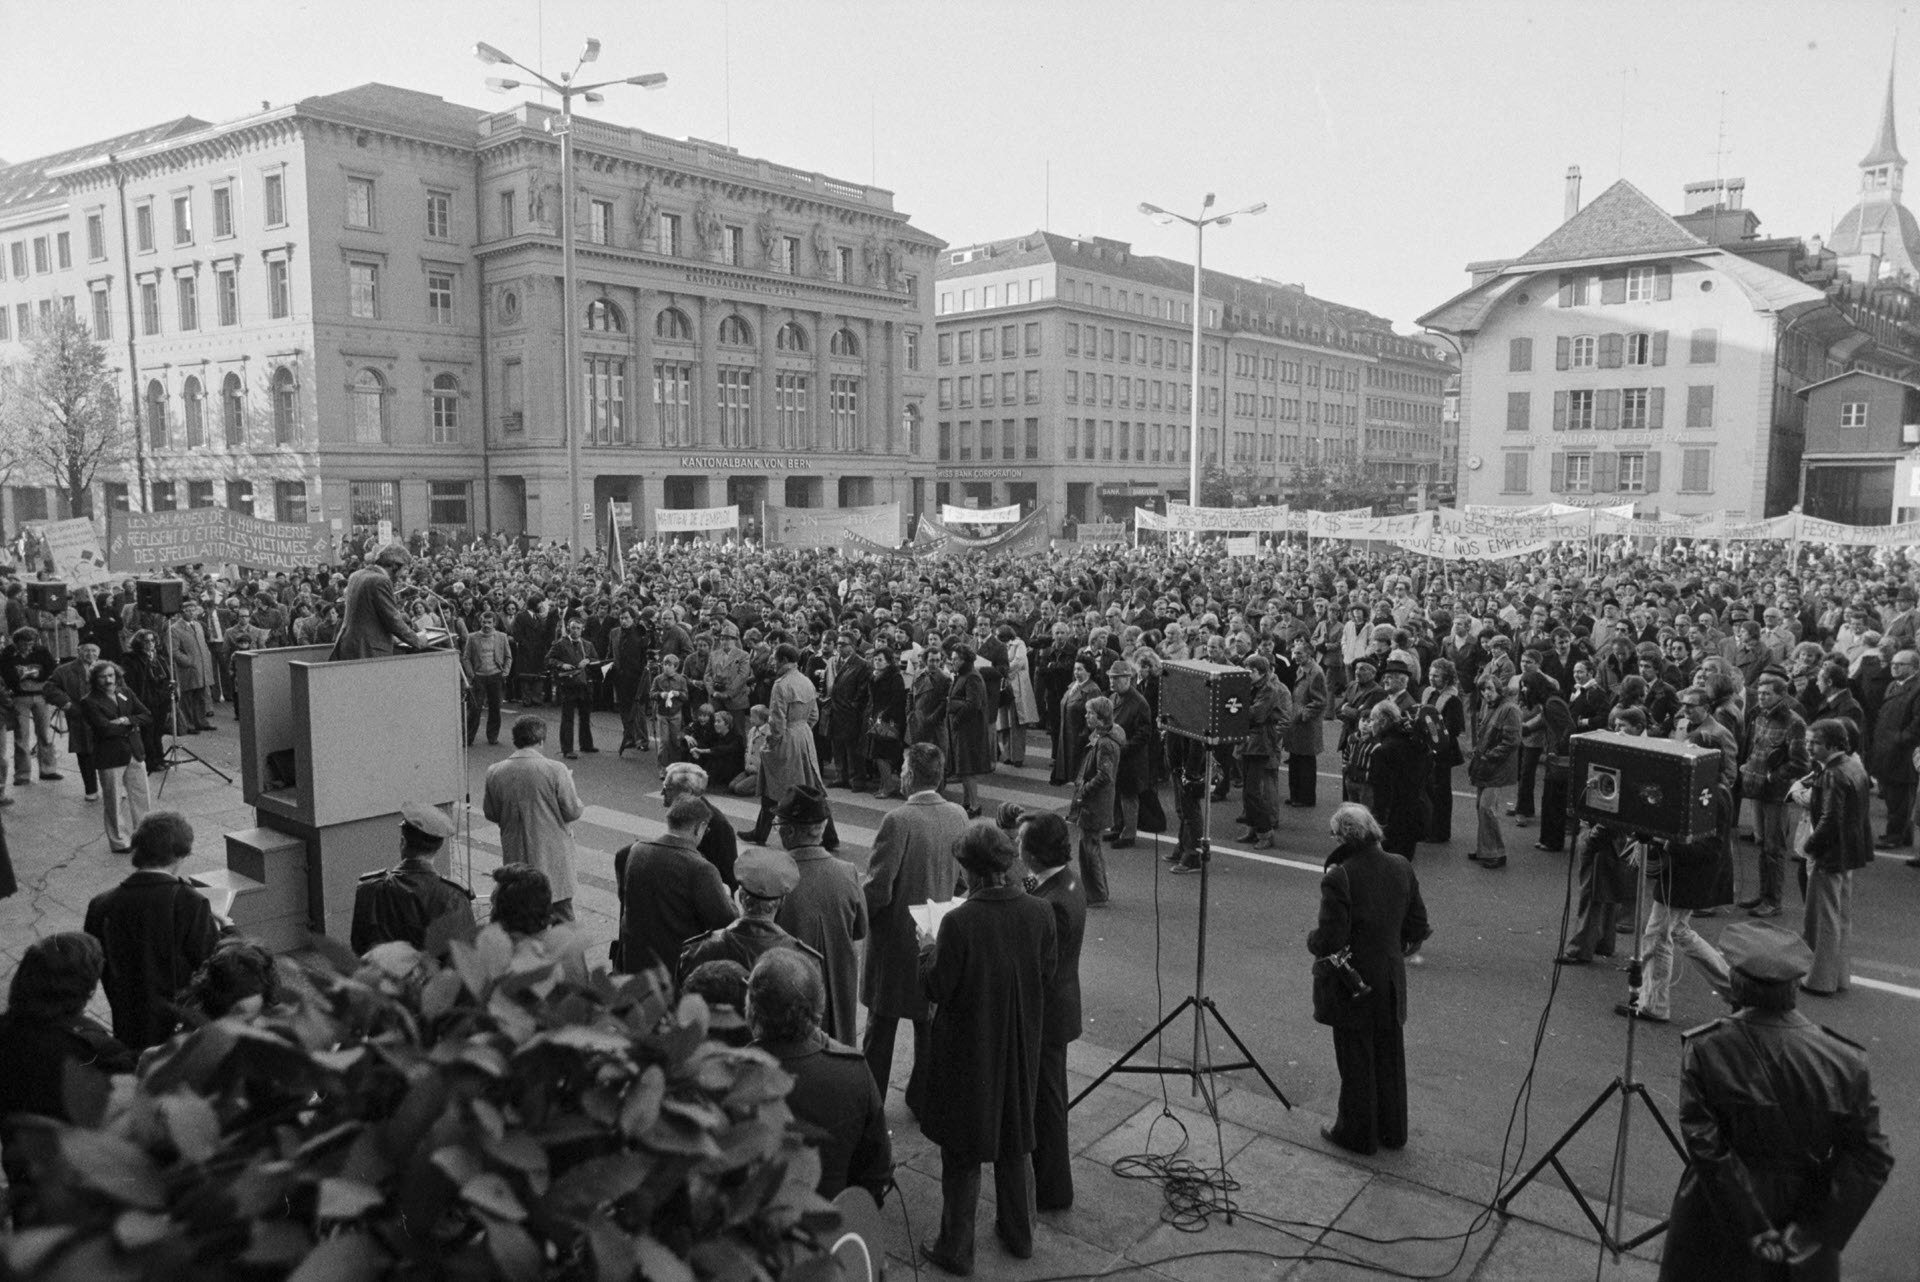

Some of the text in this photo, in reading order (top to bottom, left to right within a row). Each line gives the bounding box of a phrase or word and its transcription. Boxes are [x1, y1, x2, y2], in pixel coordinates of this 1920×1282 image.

[1522, 432, 1618, 445] RESTAURANT
[681, 457, 812, 469] KANTONALBANK VON BERN
[954, 469, 973, 478] BANK
[974, 468, 1022, 478] CORPORATION
[128, 518, 148, 529] LES
[209, 508, 226, 525] DE
[1444, 520, 1462, 534] AU
[1530, 526, 1546, 538] DE
[1549, 525, 1588, 538] TOUS
[229, 530, 249, 547] LES
[250, 535, 308, 554] VICTIMES
[1454, 541, 1480, 555] NOS
[134, 548, 156, 564] DES
